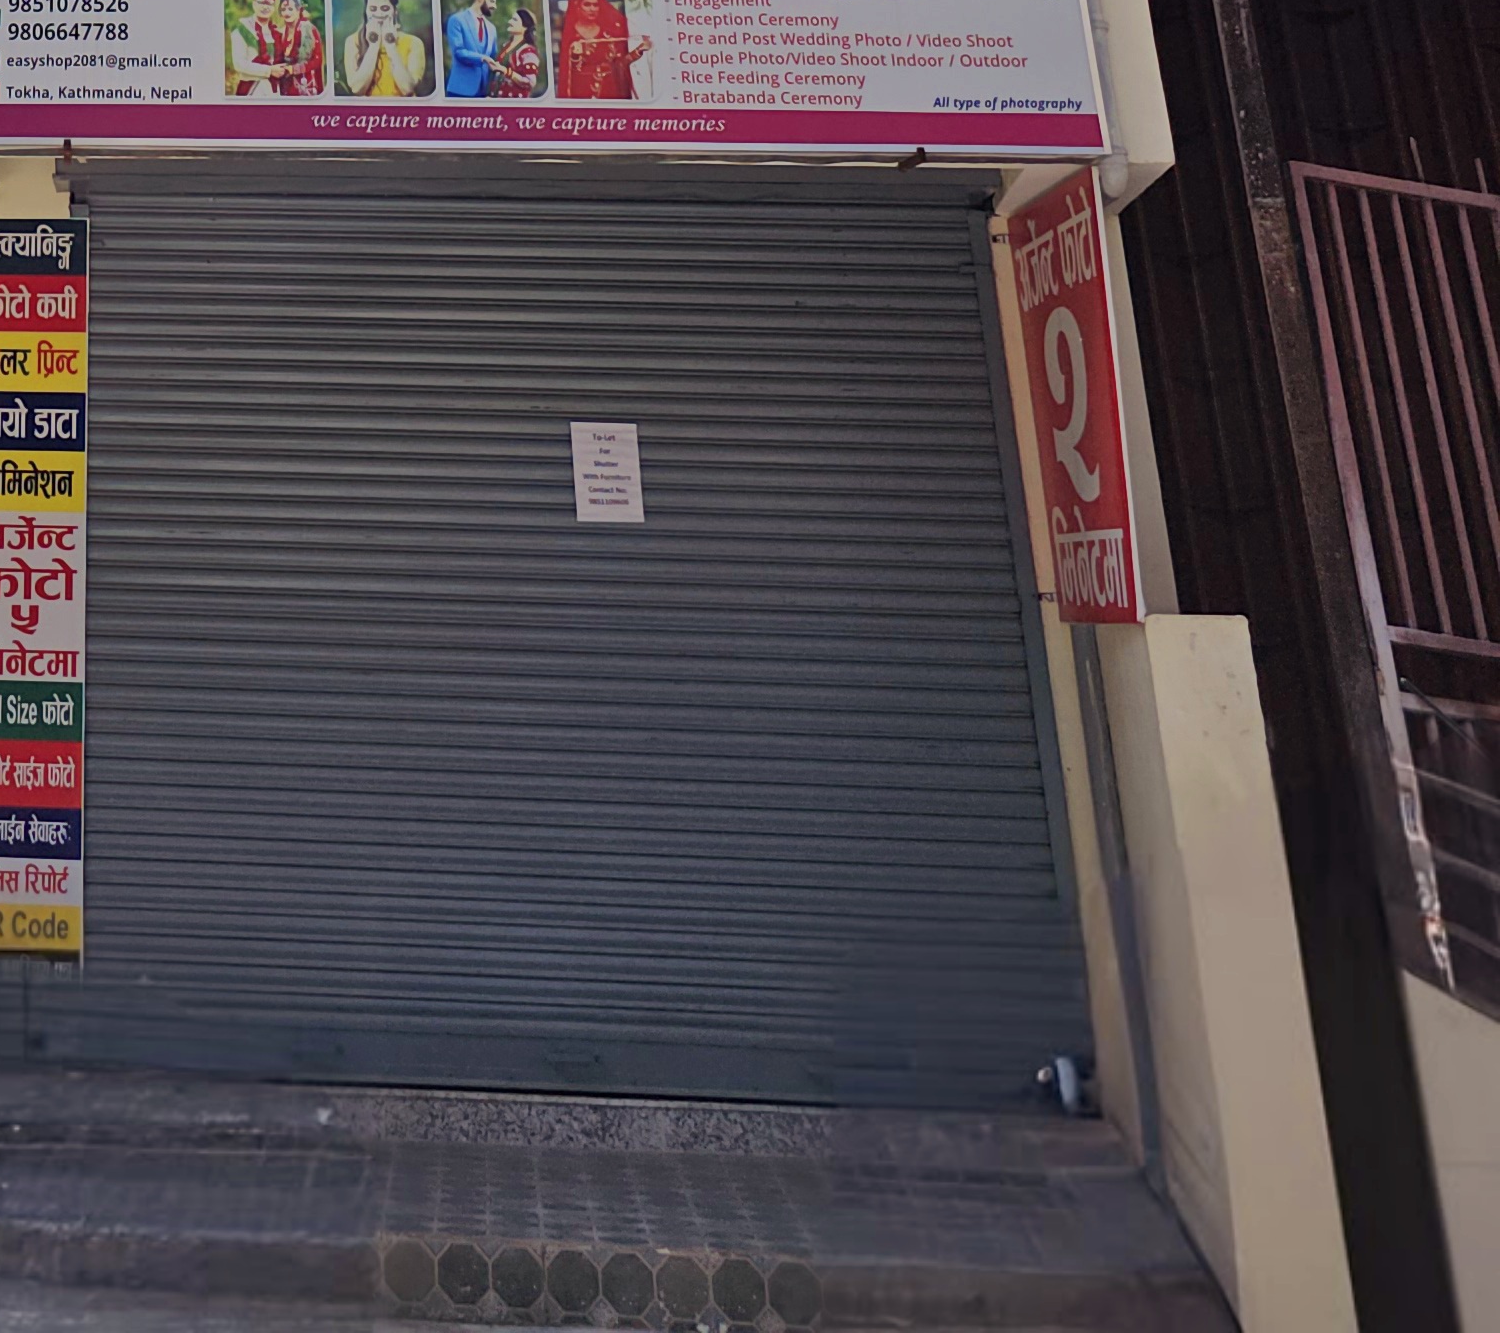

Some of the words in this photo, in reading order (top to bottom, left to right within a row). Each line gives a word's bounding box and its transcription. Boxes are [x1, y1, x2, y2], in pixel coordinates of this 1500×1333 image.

[7, 23, 129, 41] 9806647788
[675, 13, 754, 29] Reception
[758, 13, 839, 30] Ceremony
[677, 32, 704, 46] Pre
[708, 32, 738, 46] and
[742, 32, 776, 47] Post
[779, 32, 850, 50] Wedding
[854, 33, 902, 48] Photo
[916, 33, 962, 48] Video
[965, 33, 1014, 49] Shoot
[6, 54, 192, 70] easyshop2081@gmail.com
[679, 51, 734, 69] Couple
[738, 51, 836, 68] Photo/Video
[840, 52, 887, 68] Shoot
[891, 52, 943, 68] Indoor
[959, 53, 1029, 69] Outdoor
[6, 86, 54, 100] Tokha,
[58, 86, 146, 100] Kathmandu,
[151, 86, 192, 102] Nepal
[680, 70, 713, 85] Rice
[718, 70, 780, 89] Feeding
[784, 71, 866, 90] Ceremony
[682, 90, 776, 106] Bratabanda
[780, 91, 863, 109] Ceremony
[933, 97, 950, 109] All
[953, 97, 981, 112] type
[982, 96, 999, 112] of
[1000, 97, 1083, 112] photography
[311, 114, 341, 128] we
[345, 112, 419, 132] capture
[426, 113, 510, 132] moment,
[516, 115, 546, 129] we
[551, 114, 628, 133] capture
[634, 115, 725, 132] memories
[1015, 218, 1059, 312] अर्जेन्ट
[1056, 186, 1097, 289] फोटो
[36, 284, 78, 319] कपी
[37, 340, 80, 378] प्रिन्ट
[1043, 306, 1100, 502] २
[34, 408, 80, 439] डाटा
[1052, 505, 1129, 610] मिनेटमा
[11, 604, 40, 635] ५
[6, 694, 37, 725] Size
[42, 693, 74, 726] फोटो
[13, 756, 45, 791] साईज
[47, 755, 75, 788] फोटो
[24, 863, 70, 894] रिपोर्ट
[11, 910, 69, 940] Code
